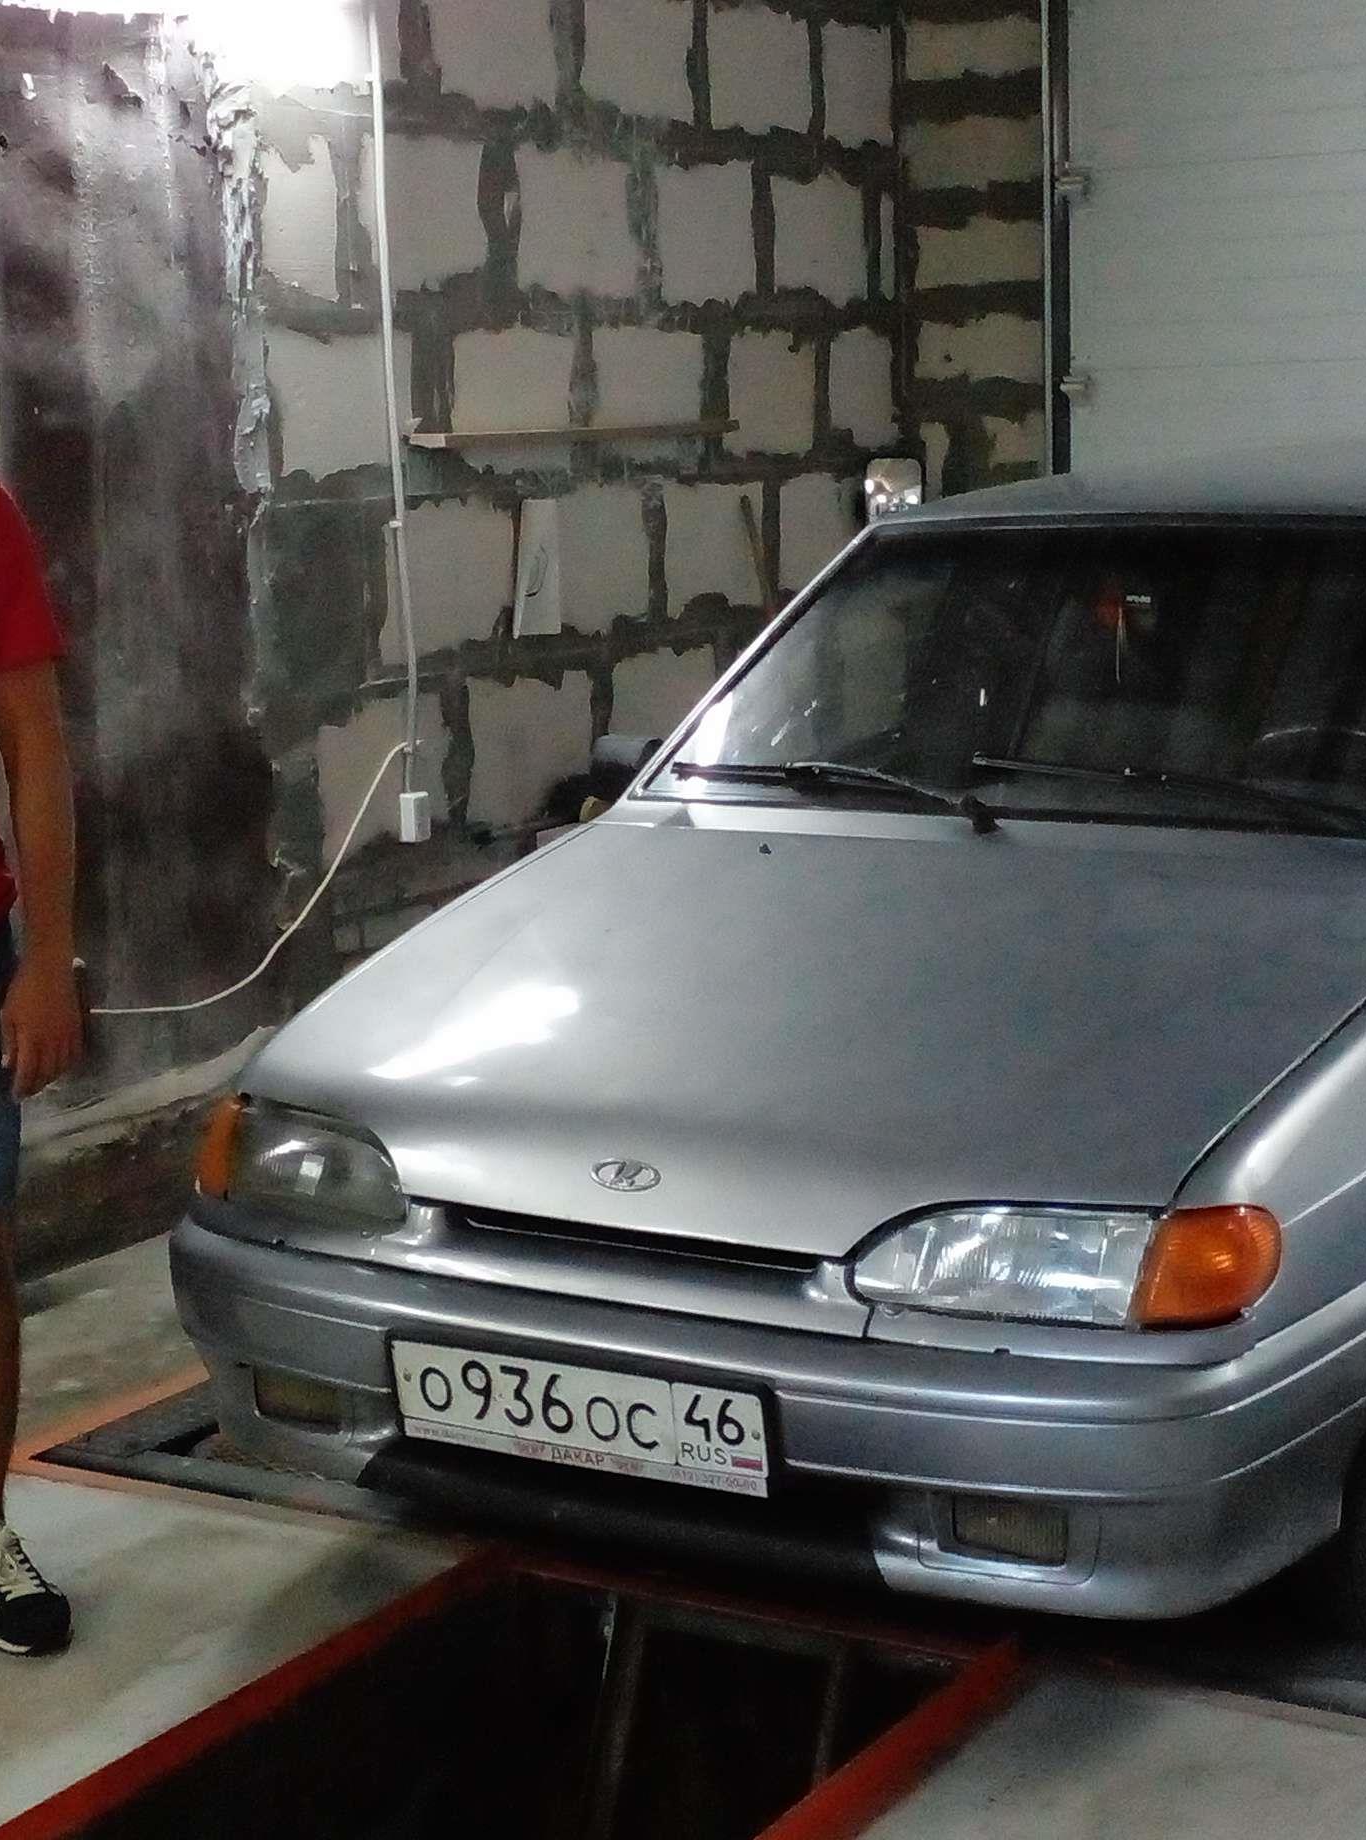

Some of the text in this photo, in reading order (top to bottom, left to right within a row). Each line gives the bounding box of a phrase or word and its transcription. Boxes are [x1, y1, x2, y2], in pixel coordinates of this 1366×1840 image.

[683, 1393, 746, 1446] 46
[550, 1447, 605, 1467] ДАКАР
[681, 1442, 727, 1465] RUS
